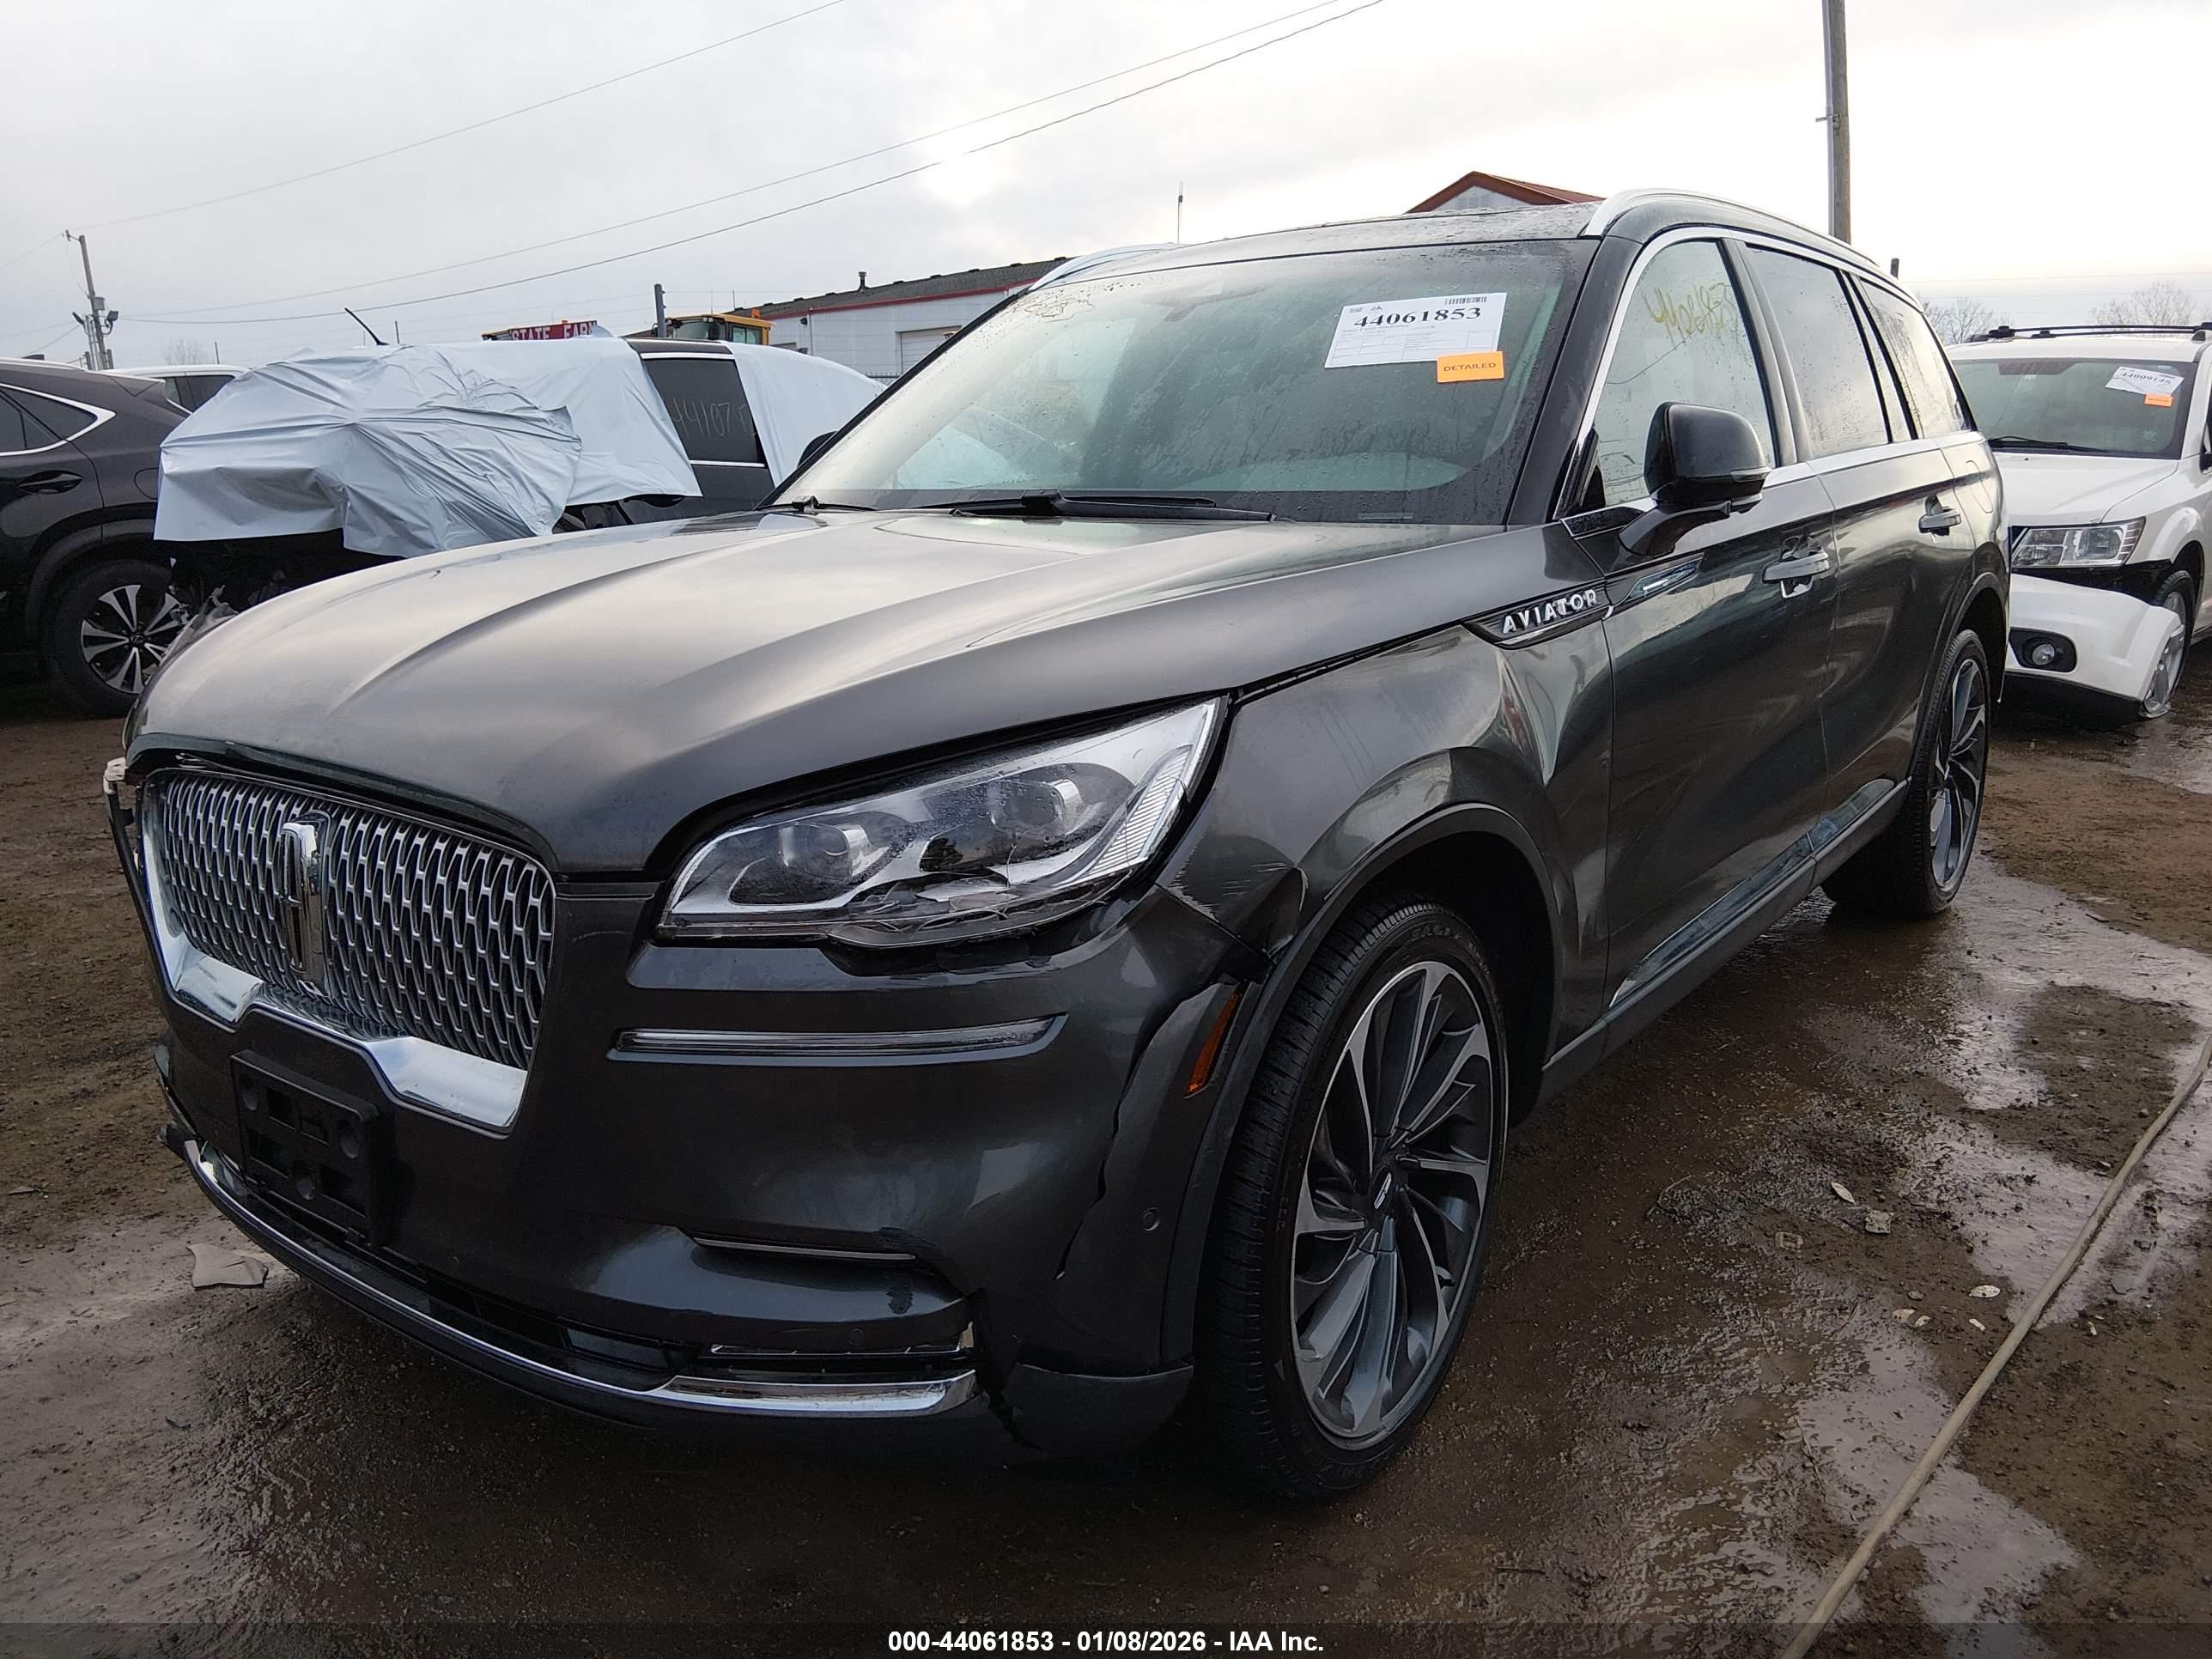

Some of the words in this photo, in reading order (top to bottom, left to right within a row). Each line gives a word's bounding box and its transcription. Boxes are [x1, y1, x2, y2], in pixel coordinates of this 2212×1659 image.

[1353, 307, 1481, 327] 44061853
[512, 326, 550, 341] STATE
[1443, 362, 1497, 372] DETAILED
[1503, 589, 1598, 635] AVIATOR
